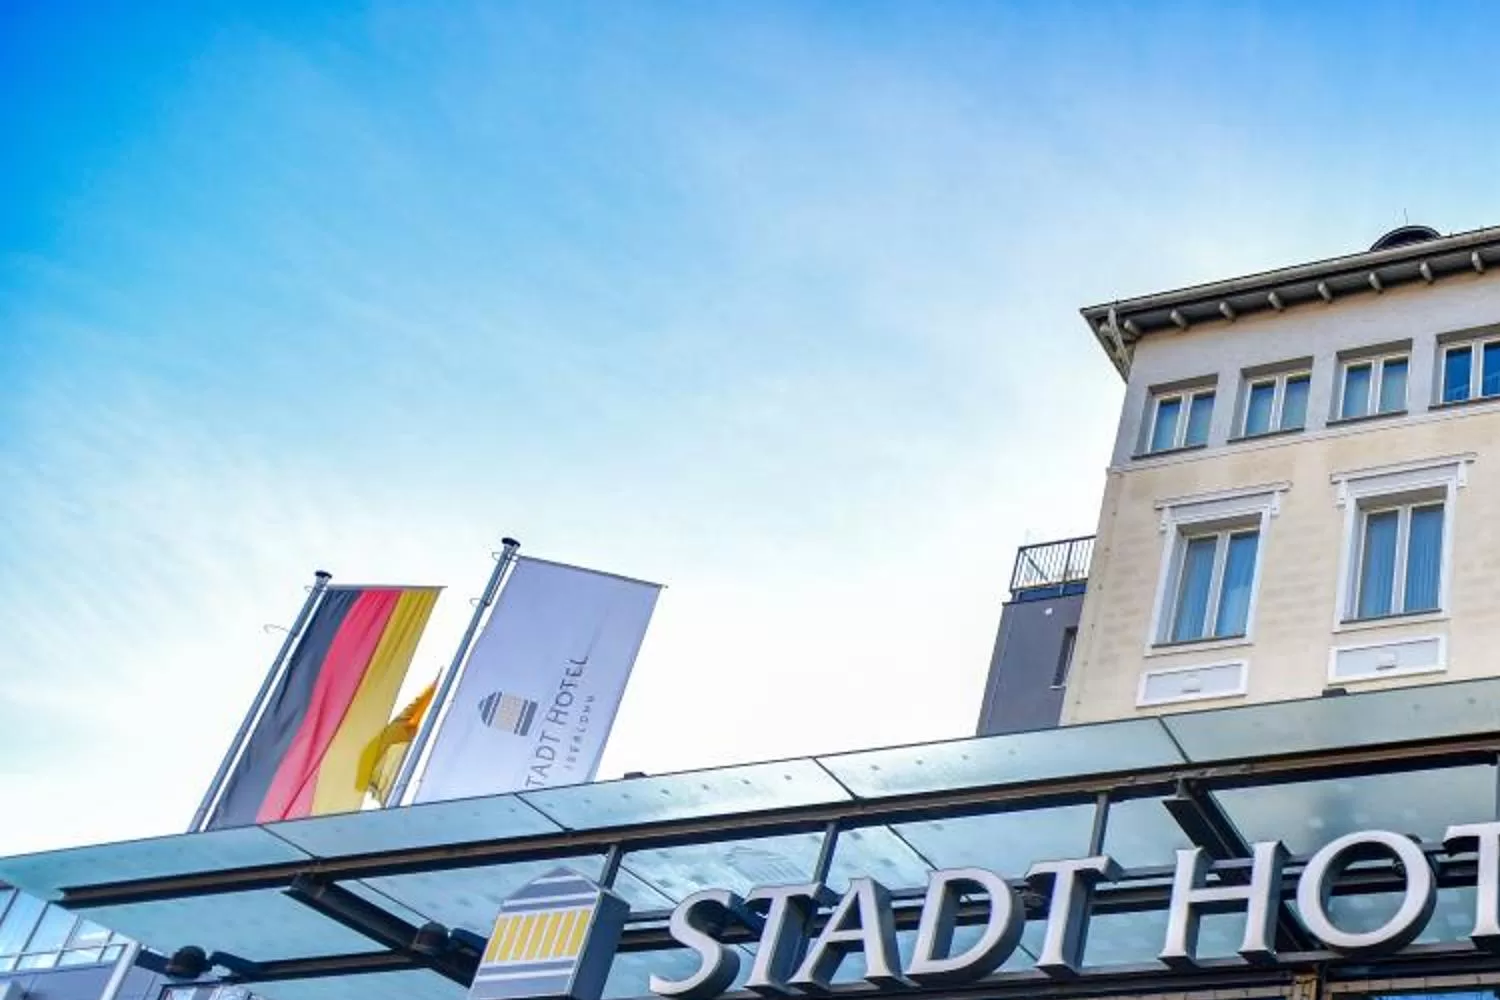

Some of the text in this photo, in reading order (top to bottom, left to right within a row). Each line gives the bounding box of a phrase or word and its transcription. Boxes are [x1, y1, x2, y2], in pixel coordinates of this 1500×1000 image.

[525, 655, 589, 788] TADT HOTEL
[649, 855, 1121, 998] STADT
